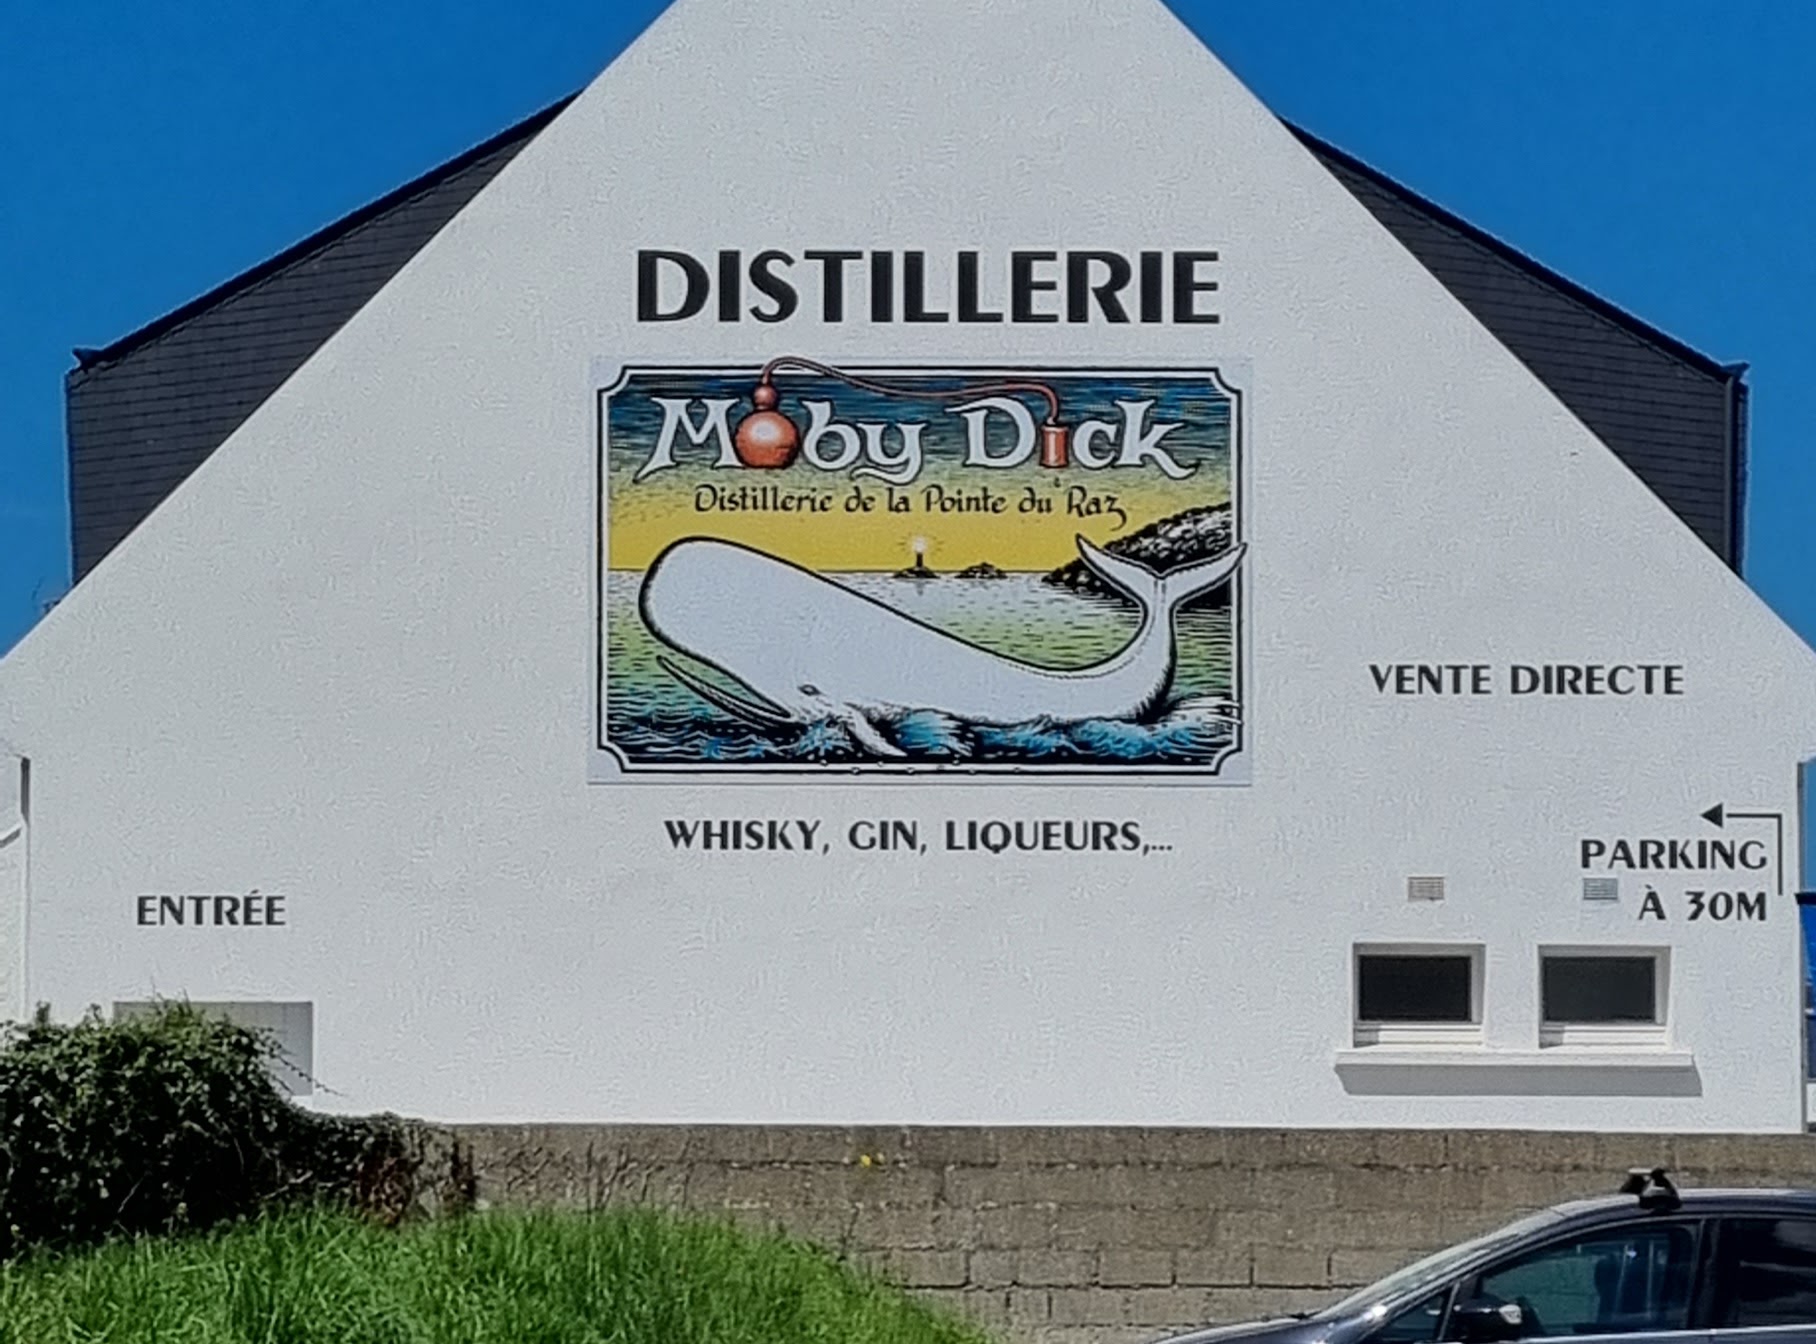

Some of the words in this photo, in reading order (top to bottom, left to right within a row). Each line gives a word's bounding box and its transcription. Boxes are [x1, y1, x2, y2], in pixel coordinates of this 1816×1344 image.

[637, 249, 1220, 325] DISTILLERIE
[635, 396, 929, 485] Moby
[944, 396, 1198, 480] Dick
[694, 484, 833, 513] Distillerie
[844, 485, 876, 513] de
[886, 486, 911, 513] la
[921, 484, 1007, 513] Pointe
[1018, 486, 1053, 513] du
[1066, 485, 1127, 532] Raz
[1369, 664, 1492, 695] VENTE
[1510, 665, 1684, 695] DIRECTE
[664, 820, 830, 855] WHISKY,
[848, 820, 927, 855] GIN,
[946, 820, 1173, 855] LIQUEURS,...
[1581, 839, 1767, 870] PARKING
[137, 889, 286, 926] ENTRÉE
[1638, 884, 1666, 921] À
[1685, 891, 1767, 921] 30M
